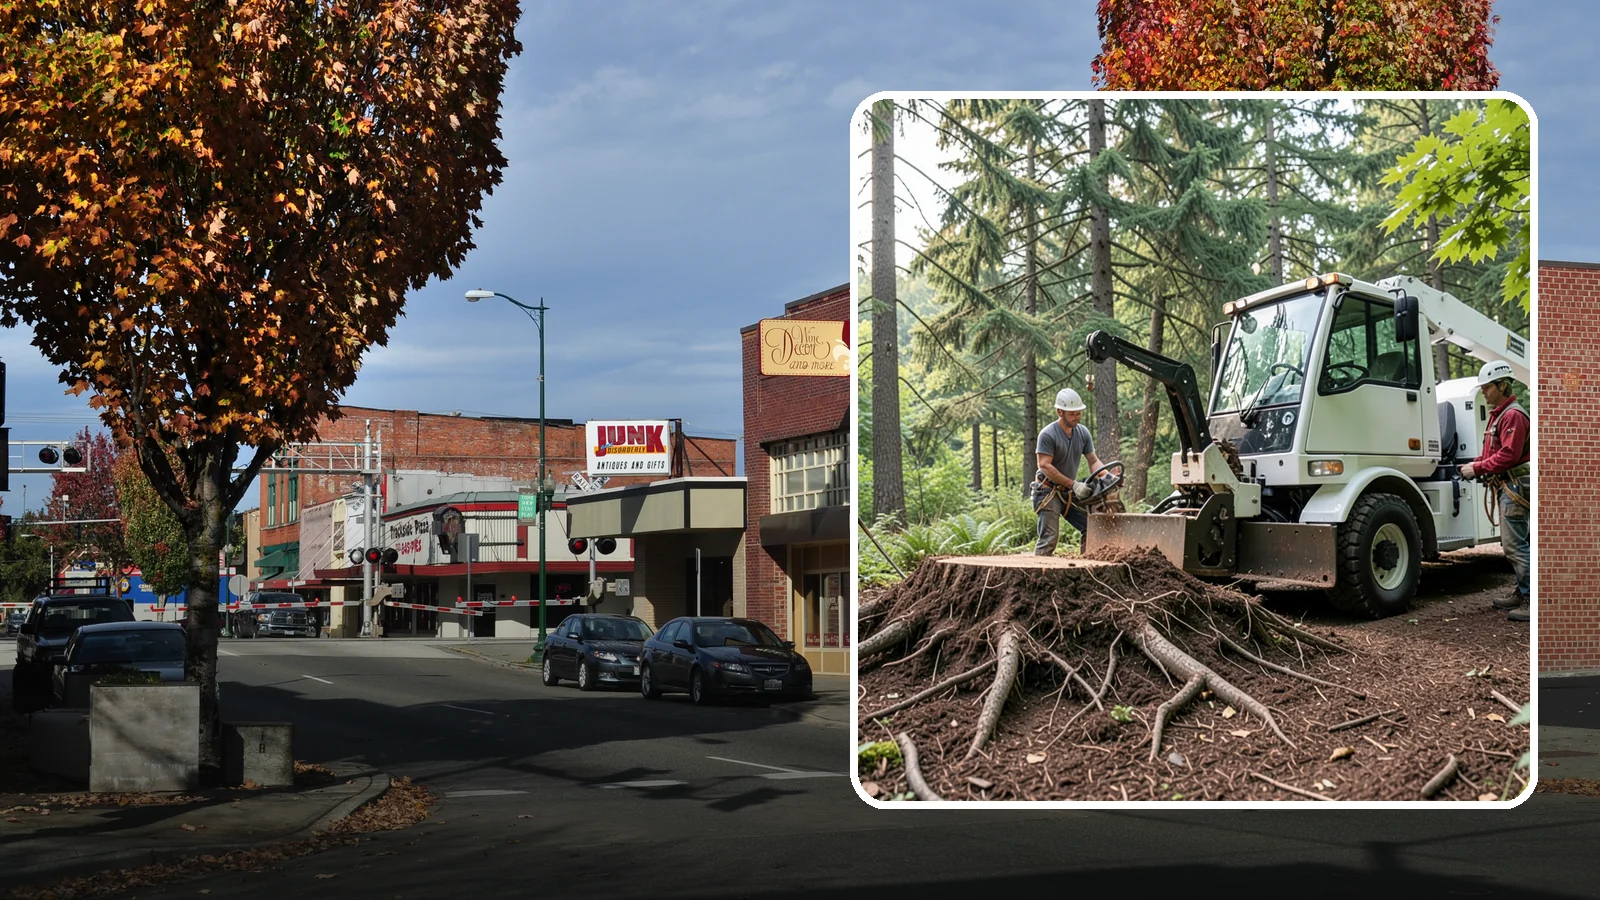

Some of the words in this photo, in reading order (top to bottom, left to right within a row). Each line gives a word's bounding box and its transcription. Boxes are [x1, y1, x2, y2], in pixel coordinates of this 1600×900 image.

[595, 425, 665, 457] JUNK
[607, 446, 646, 454] DISORDERLY
[596, 461, 628, 470] ANTIQUES
[631, 461, 644, 470] AND
[646, 460, 665, 469] GIFTS
[352, 498, 365, 511] CRO
[390, 522, 413, 539] Trackside
[414, 519, 429, 535] Pizza
